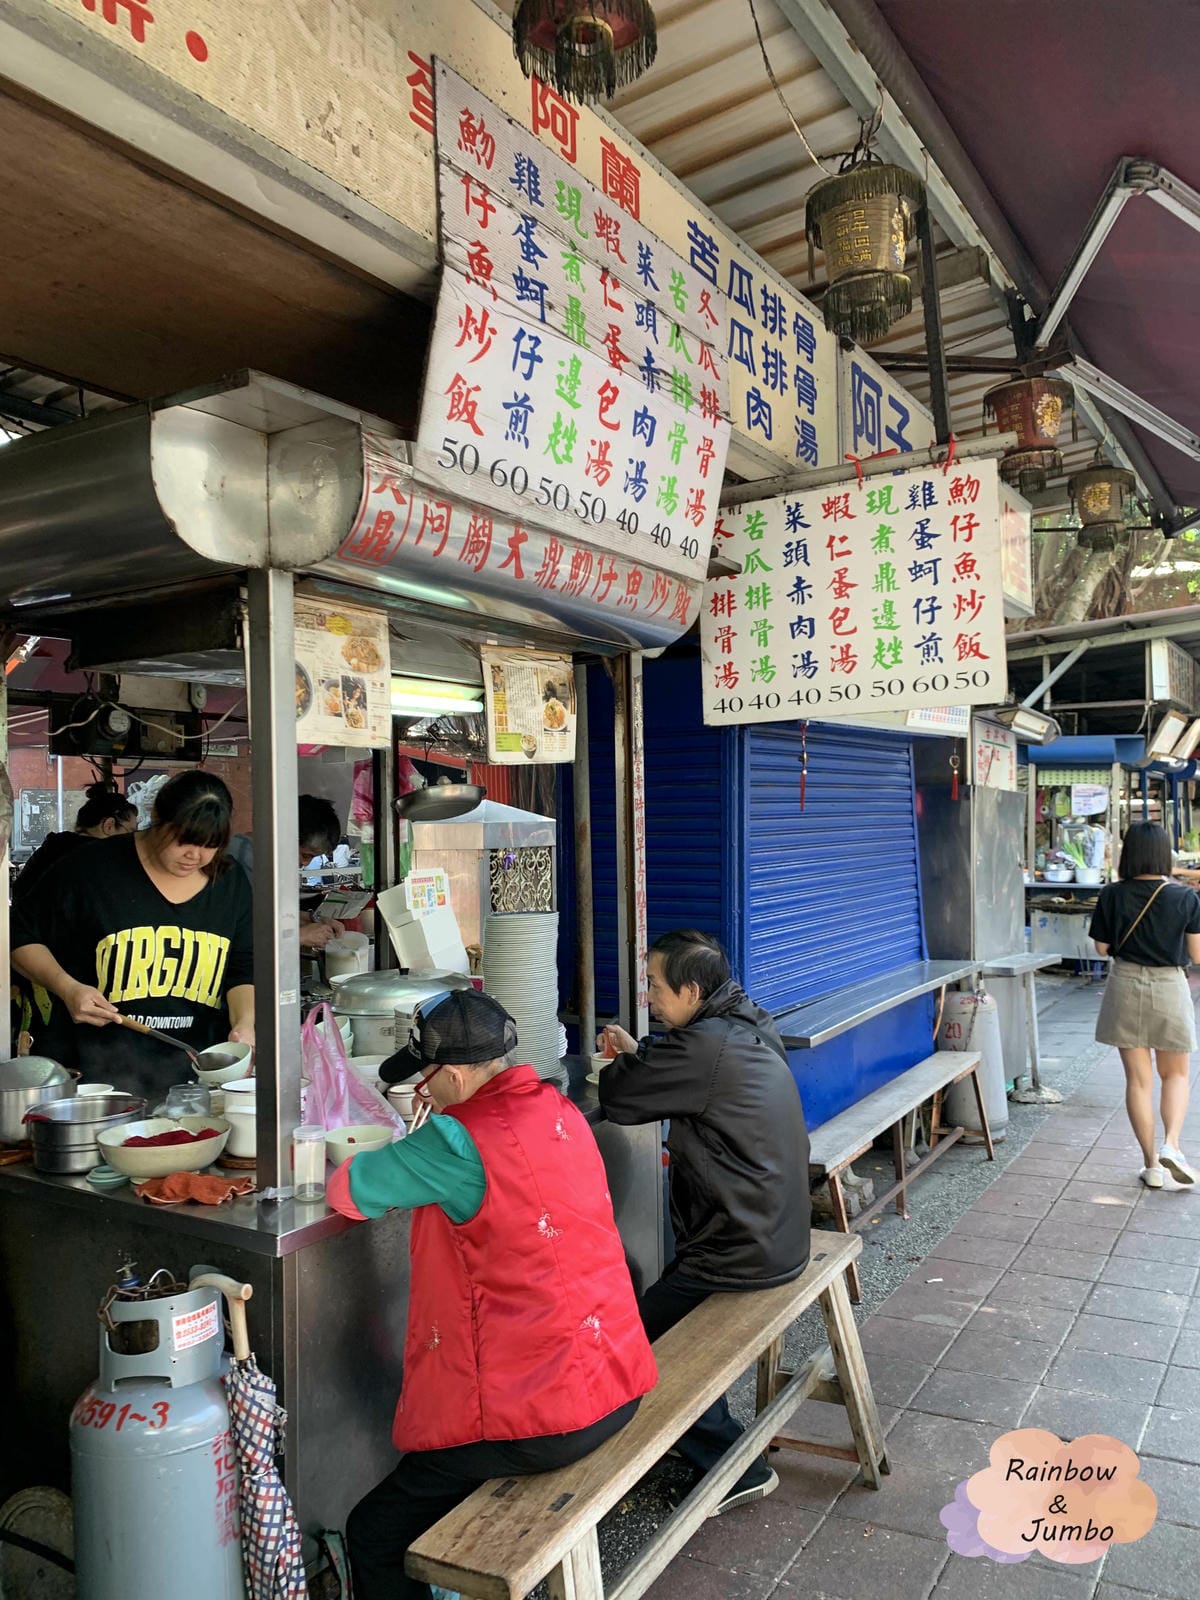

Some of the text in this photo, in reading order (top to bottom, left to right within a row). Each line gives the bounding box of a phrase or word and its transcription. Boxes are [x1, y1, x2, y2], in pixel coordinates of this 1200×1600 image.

[502, 152, 549, 449] 雞蛋蚵仔煎
[584, 207, 631, 487] 蝦仁蛋包湯
[686, 219, 817, 364] 苦瓜排骨
[655, 267, 694, 516] 苦瓜排骨湯
[684, 289, 722, 528] 冬瓜排骨湯
[437, 437, 699, 560] 50 60 50 50 40 40 40
[821, 492, 859, 674] 蝦仁蛋包湯
[904, 480, 944, 666] 雞蛋蚵仔煎
[708, 516, 739, 689] 冬排骨湯
[742, 509, 776, 686] 苦瓜排骨湯
[712, 669, 991, 714] 40 40 40 50 50 60 50
[95, 925, 231, 1009] VIRGINI
[145, 1015, 194, 1029] DOWNTOWN
